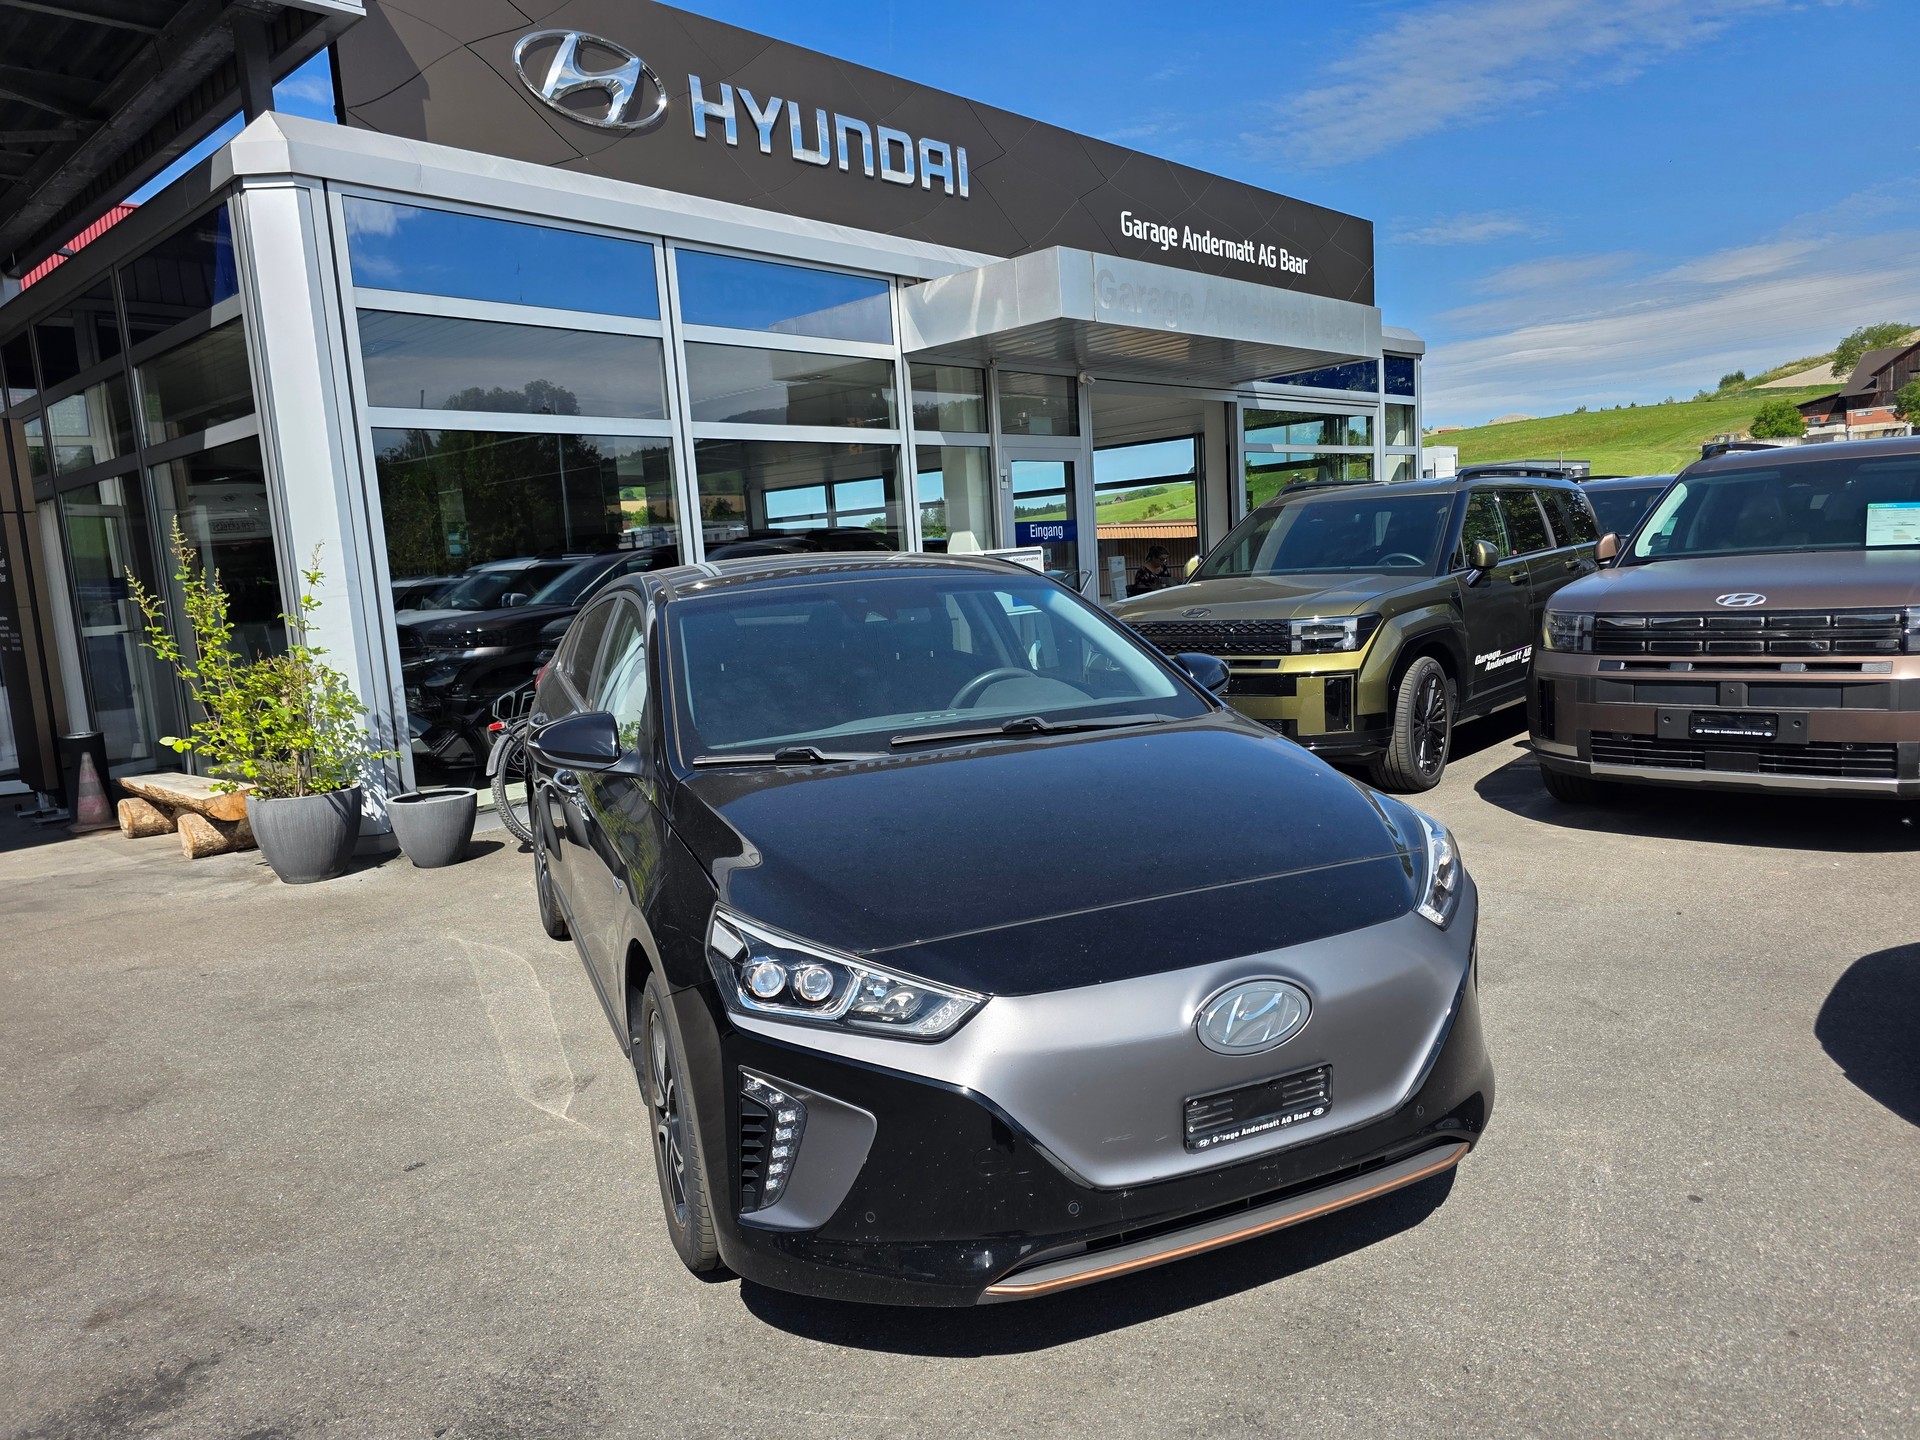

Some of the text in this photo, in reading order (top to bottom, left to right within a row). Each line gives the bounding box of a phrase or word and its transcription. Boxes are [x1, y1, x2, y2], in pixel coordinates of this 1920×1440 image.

[688, 73, 969, 199] HYUNDAI
[1120, 210, 1309, 275] Garage Andermatt AG Baar
[1029, 523, 1064, 539] Eingang
[1475, 650, 1501, 665] Garage
[1485, 650, 1522, 671] Andermatt
[1241, 1119, 1279, 1136] Andermatt
[1281, 1115, 1292, 1125] AG
[1293, 1110, 1311, 1121] Baar
